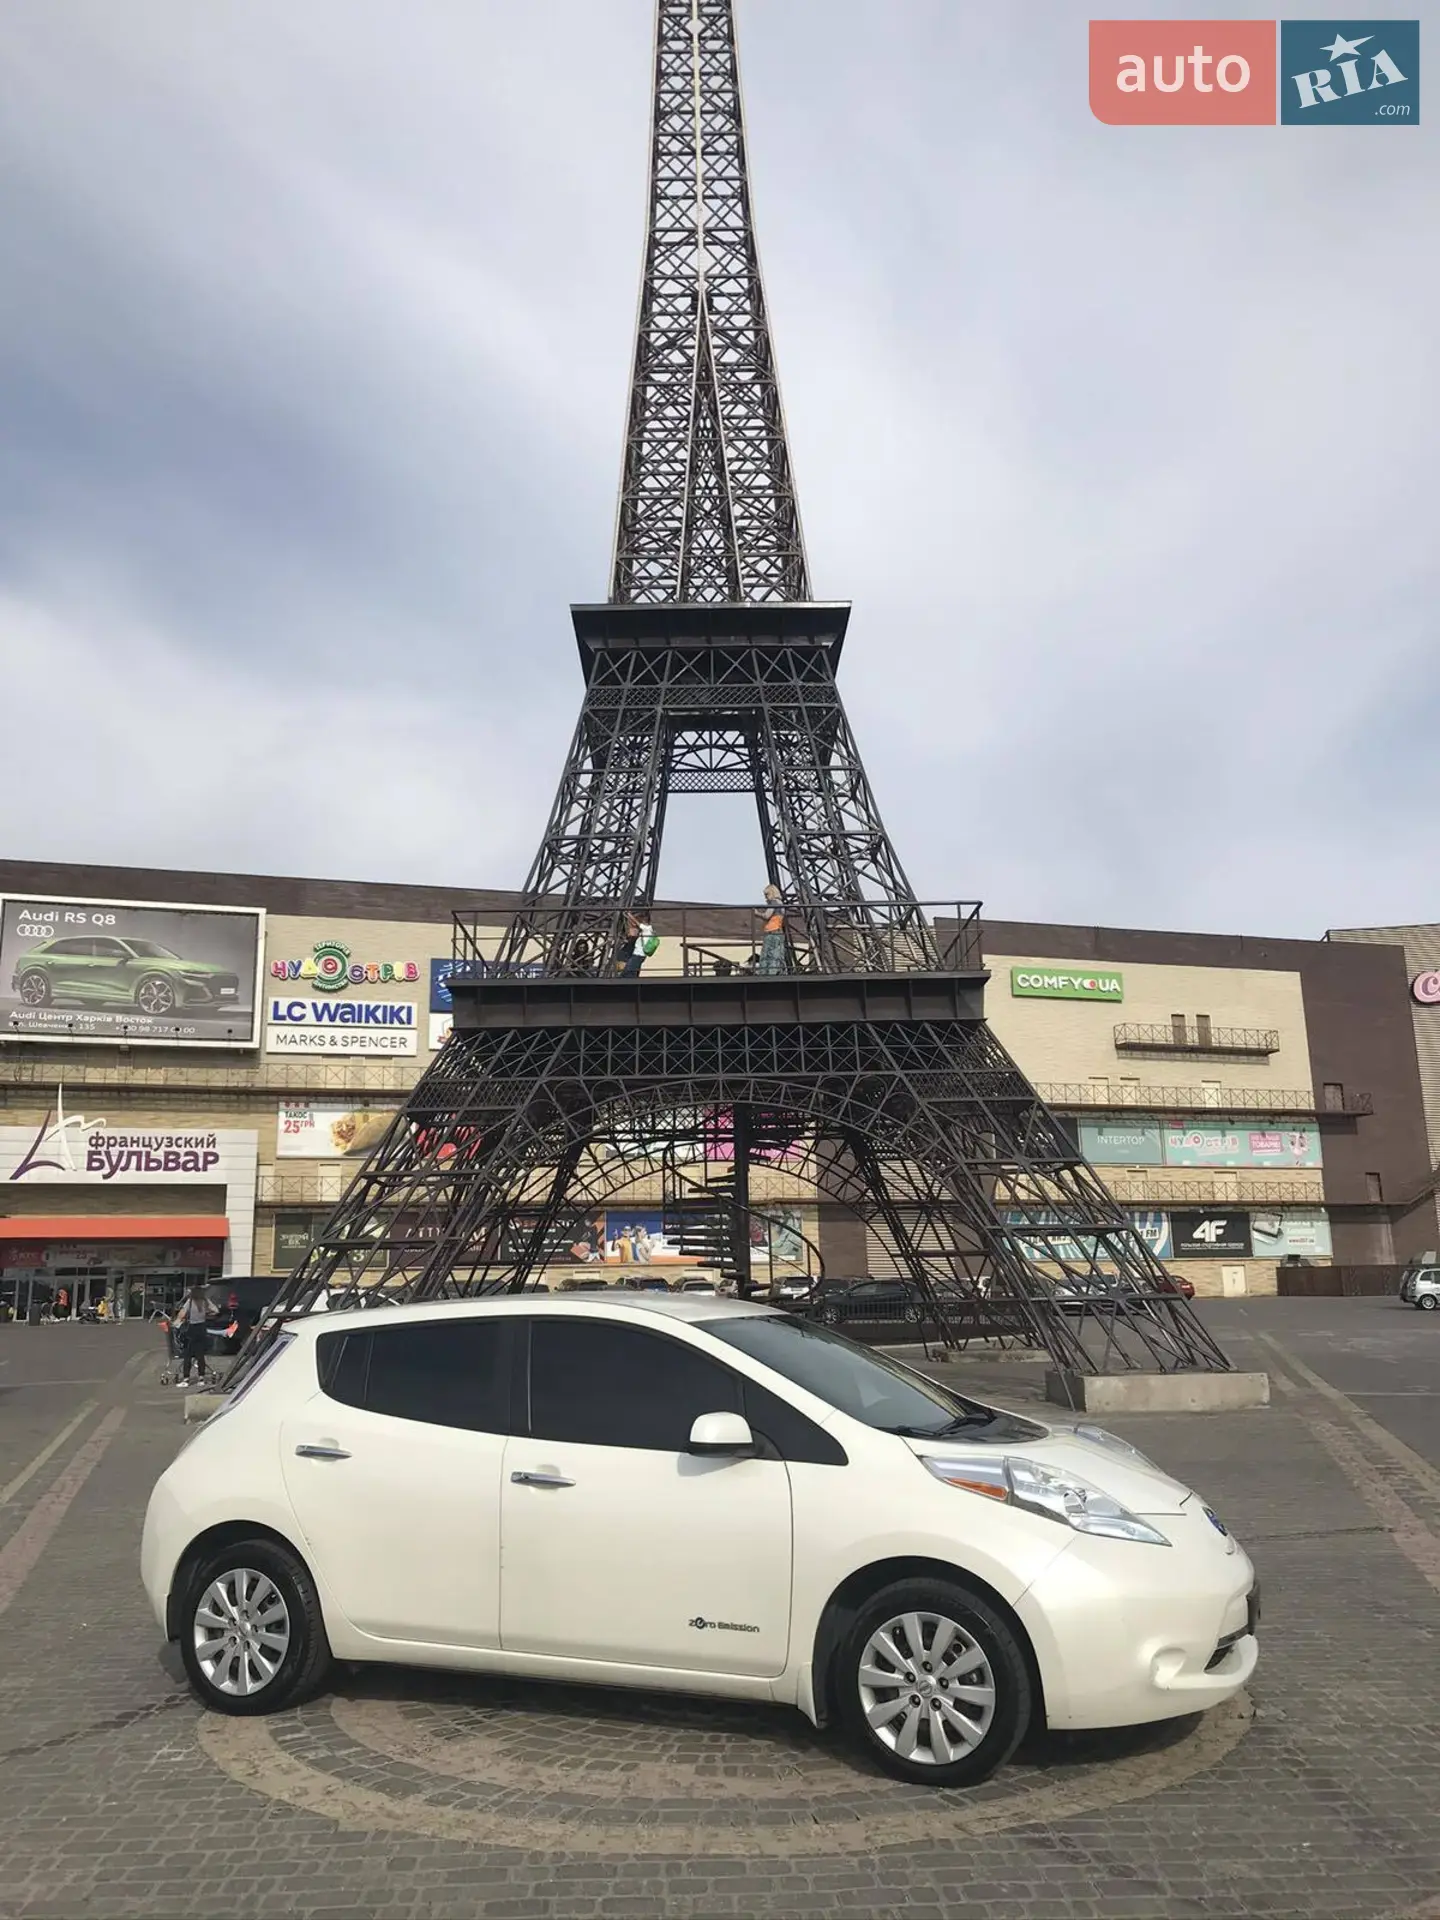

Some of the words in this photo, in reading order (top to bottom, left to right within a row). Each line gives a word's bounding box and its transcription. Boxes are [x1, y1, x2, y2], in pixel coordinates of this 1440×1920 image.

[19, 910, 59, 922] Audi
[64, 912, 87, 924] RS
[92, 913, 116, 926] Q8
[1017, 974, 1083, 990] COMFY
[1099, 979, 1121, 992] UA
[9, 1011, 36, 1019] Audi
[273, 1001, 306, 1022] LC
[276, 1034, 326, 1047] MARKS
[330, 1036, 338, 1047] &
[341, 1036, 408, 1049] SPENCER
[284, 1120, 300, 1134] 25
[88, 1131, 217, 1151] французский
[1097, 1135, 1145, 1145] INTERTOP
[1192, 1220, 1227, 1243] 4F
